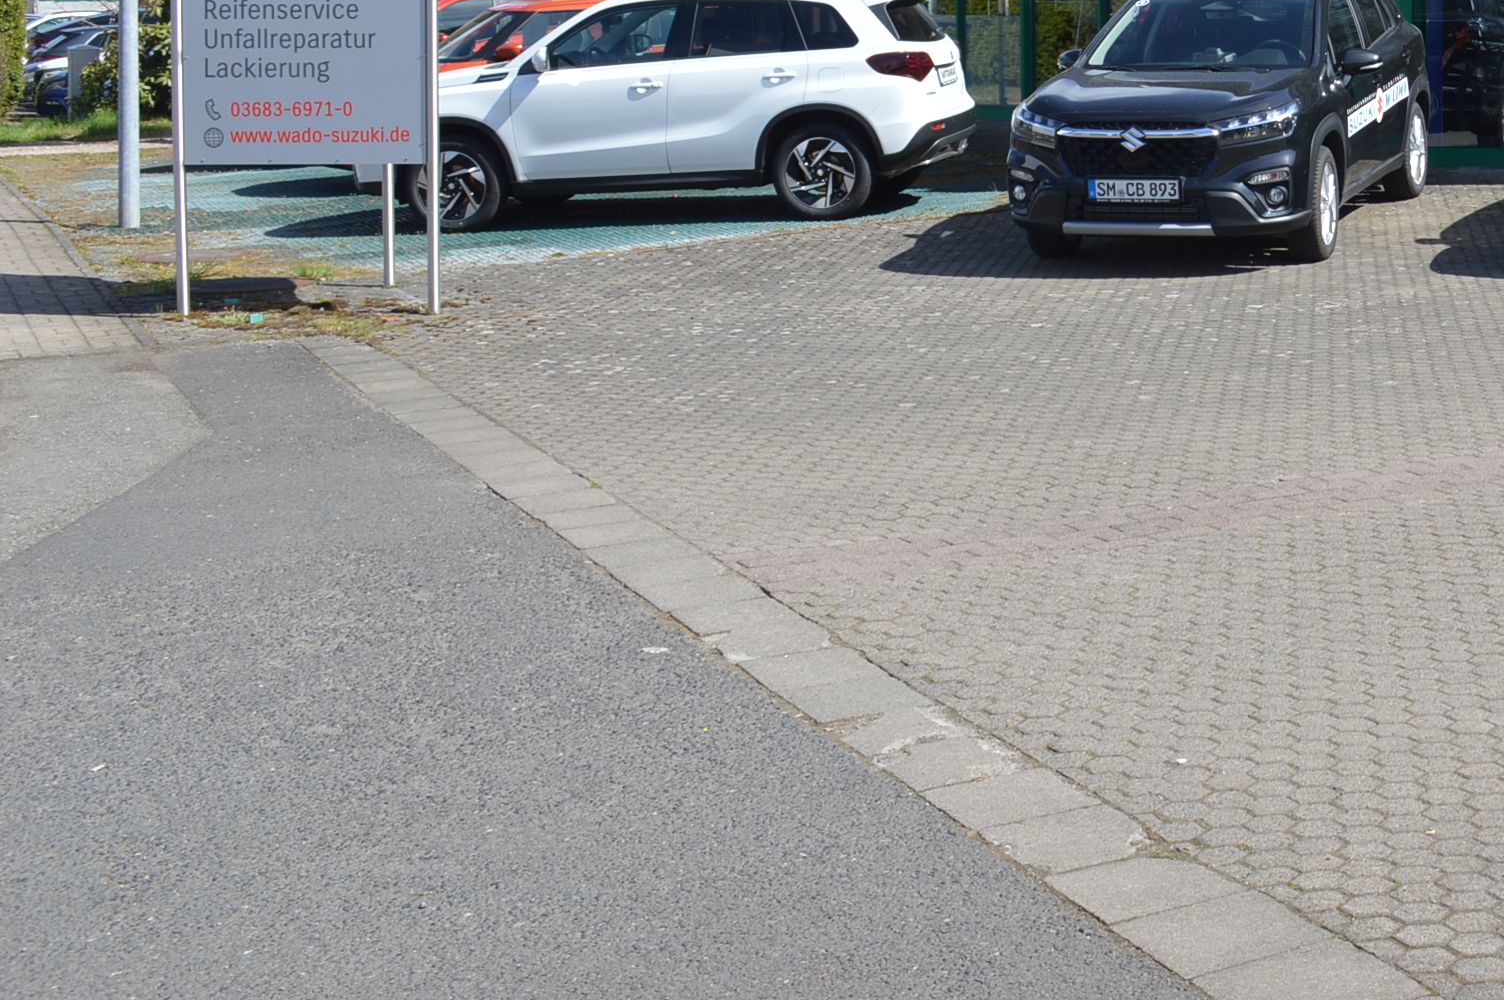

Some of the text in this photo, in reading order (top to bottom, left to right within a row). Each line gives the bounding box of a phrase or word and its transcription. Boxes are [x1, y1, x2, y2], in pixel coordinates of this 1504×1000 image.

[203, 0, 360, 20] Reifenservice
[203, 28, 377, 53] Unfallreparatur
[203, 57, 331, 84] Lackierung
[230, 101, 353, 118] 03683-6971-0
[229, 126, 411, 143] www.wado-suzuki.de
[1097, 182, 1177, 197] SM CB 893
